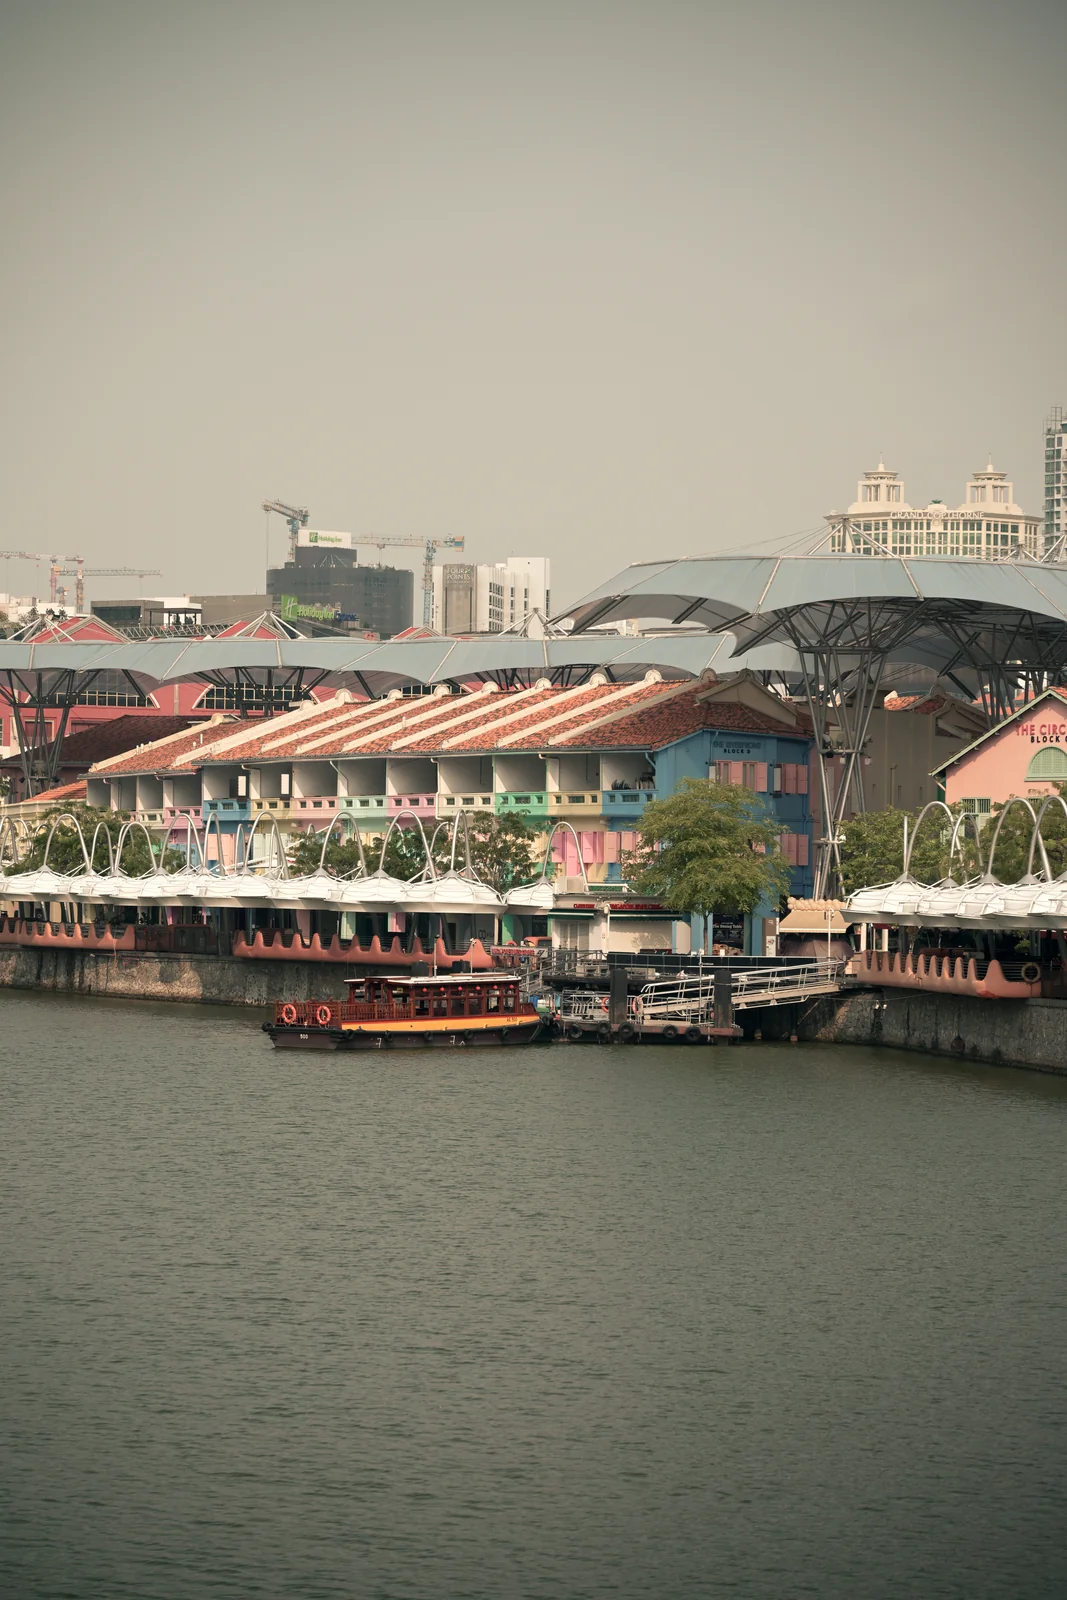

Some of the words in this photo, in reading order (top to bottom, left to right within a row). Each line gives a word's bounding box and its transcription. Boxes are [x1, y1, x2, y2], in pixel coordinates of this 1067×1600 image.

[890, 511, 924, 519] GRAND
[927, 511, 985, 520] COPTHORNE
[297, 604, 324, 620] Holiday
[1016, 724, 1035, 736] THE
